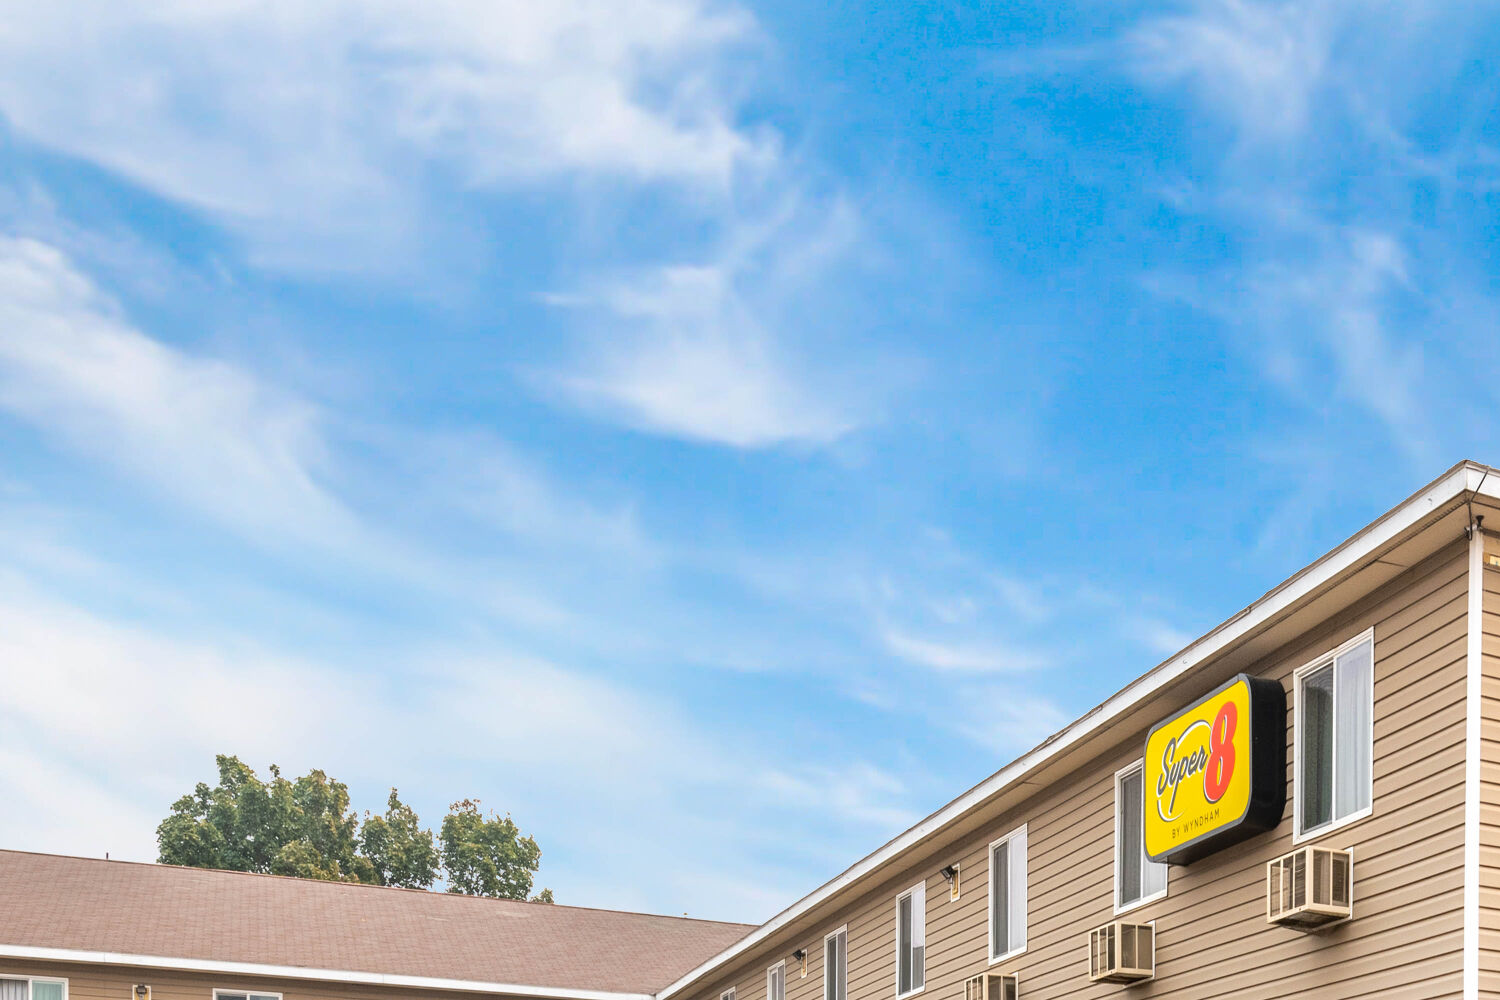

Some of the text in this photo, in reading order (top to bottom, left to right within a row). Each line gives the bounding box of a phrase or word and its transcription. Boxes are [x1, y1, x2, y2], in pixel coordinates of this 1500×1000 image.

[1157, 701, 1238, 816] Super 8
[1172, 808, 1220, 839] BY WYNDHAM
